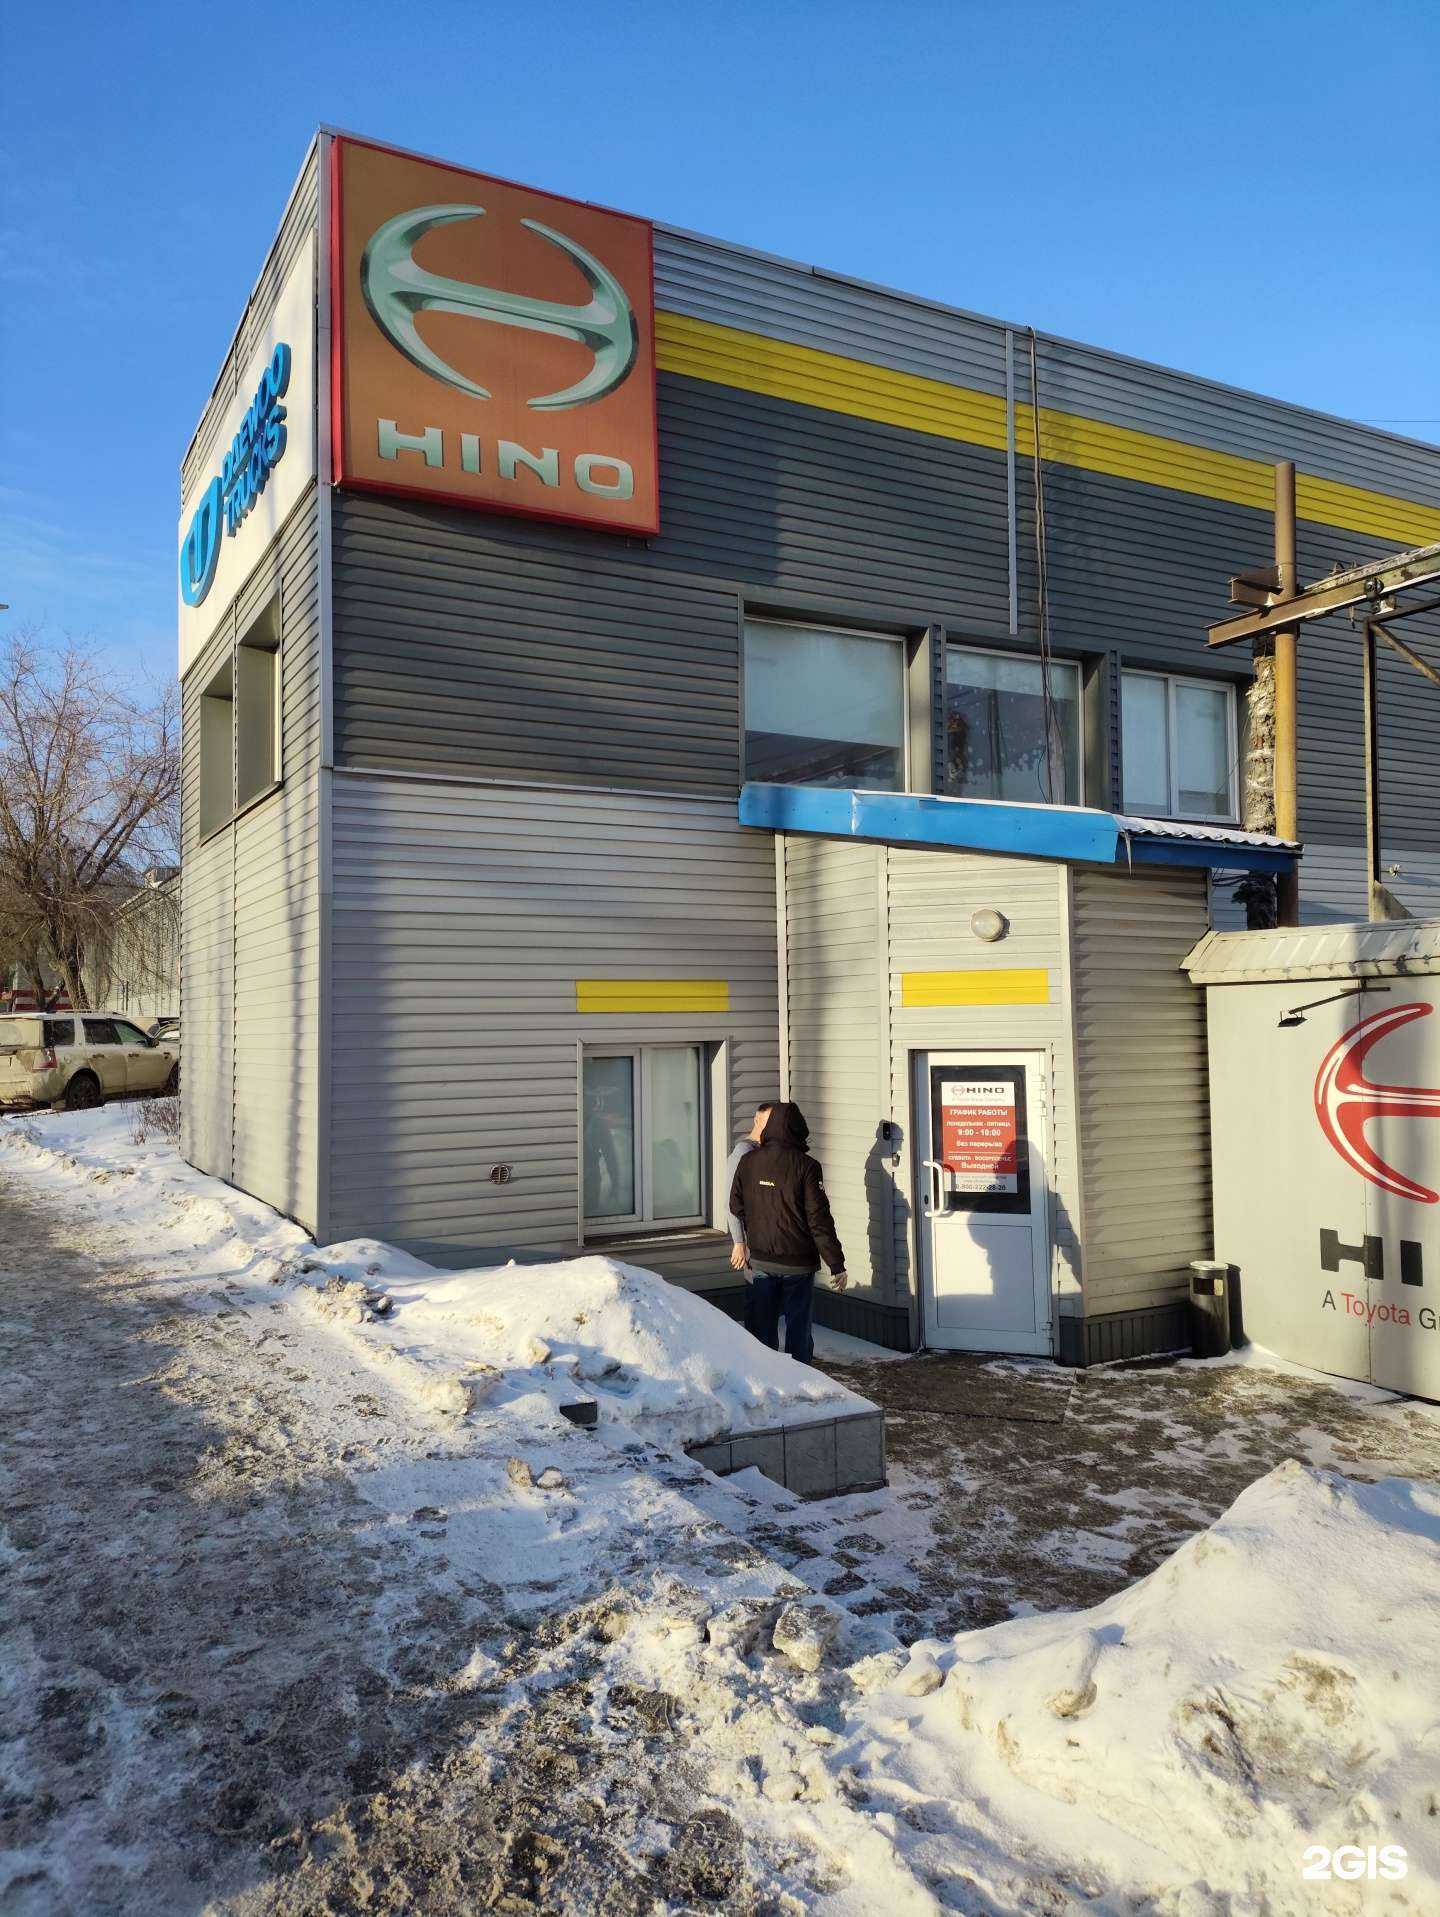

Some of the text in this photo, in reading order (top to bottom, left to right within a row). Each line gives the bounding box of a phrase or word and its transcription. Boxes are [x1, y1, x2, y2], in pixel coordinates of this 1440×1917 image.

[223, 404, 288, 538] TRUCKS
[377, 418, 635, 500] HINO
[1321, 1289, 1440, 1331] A Toyota G
